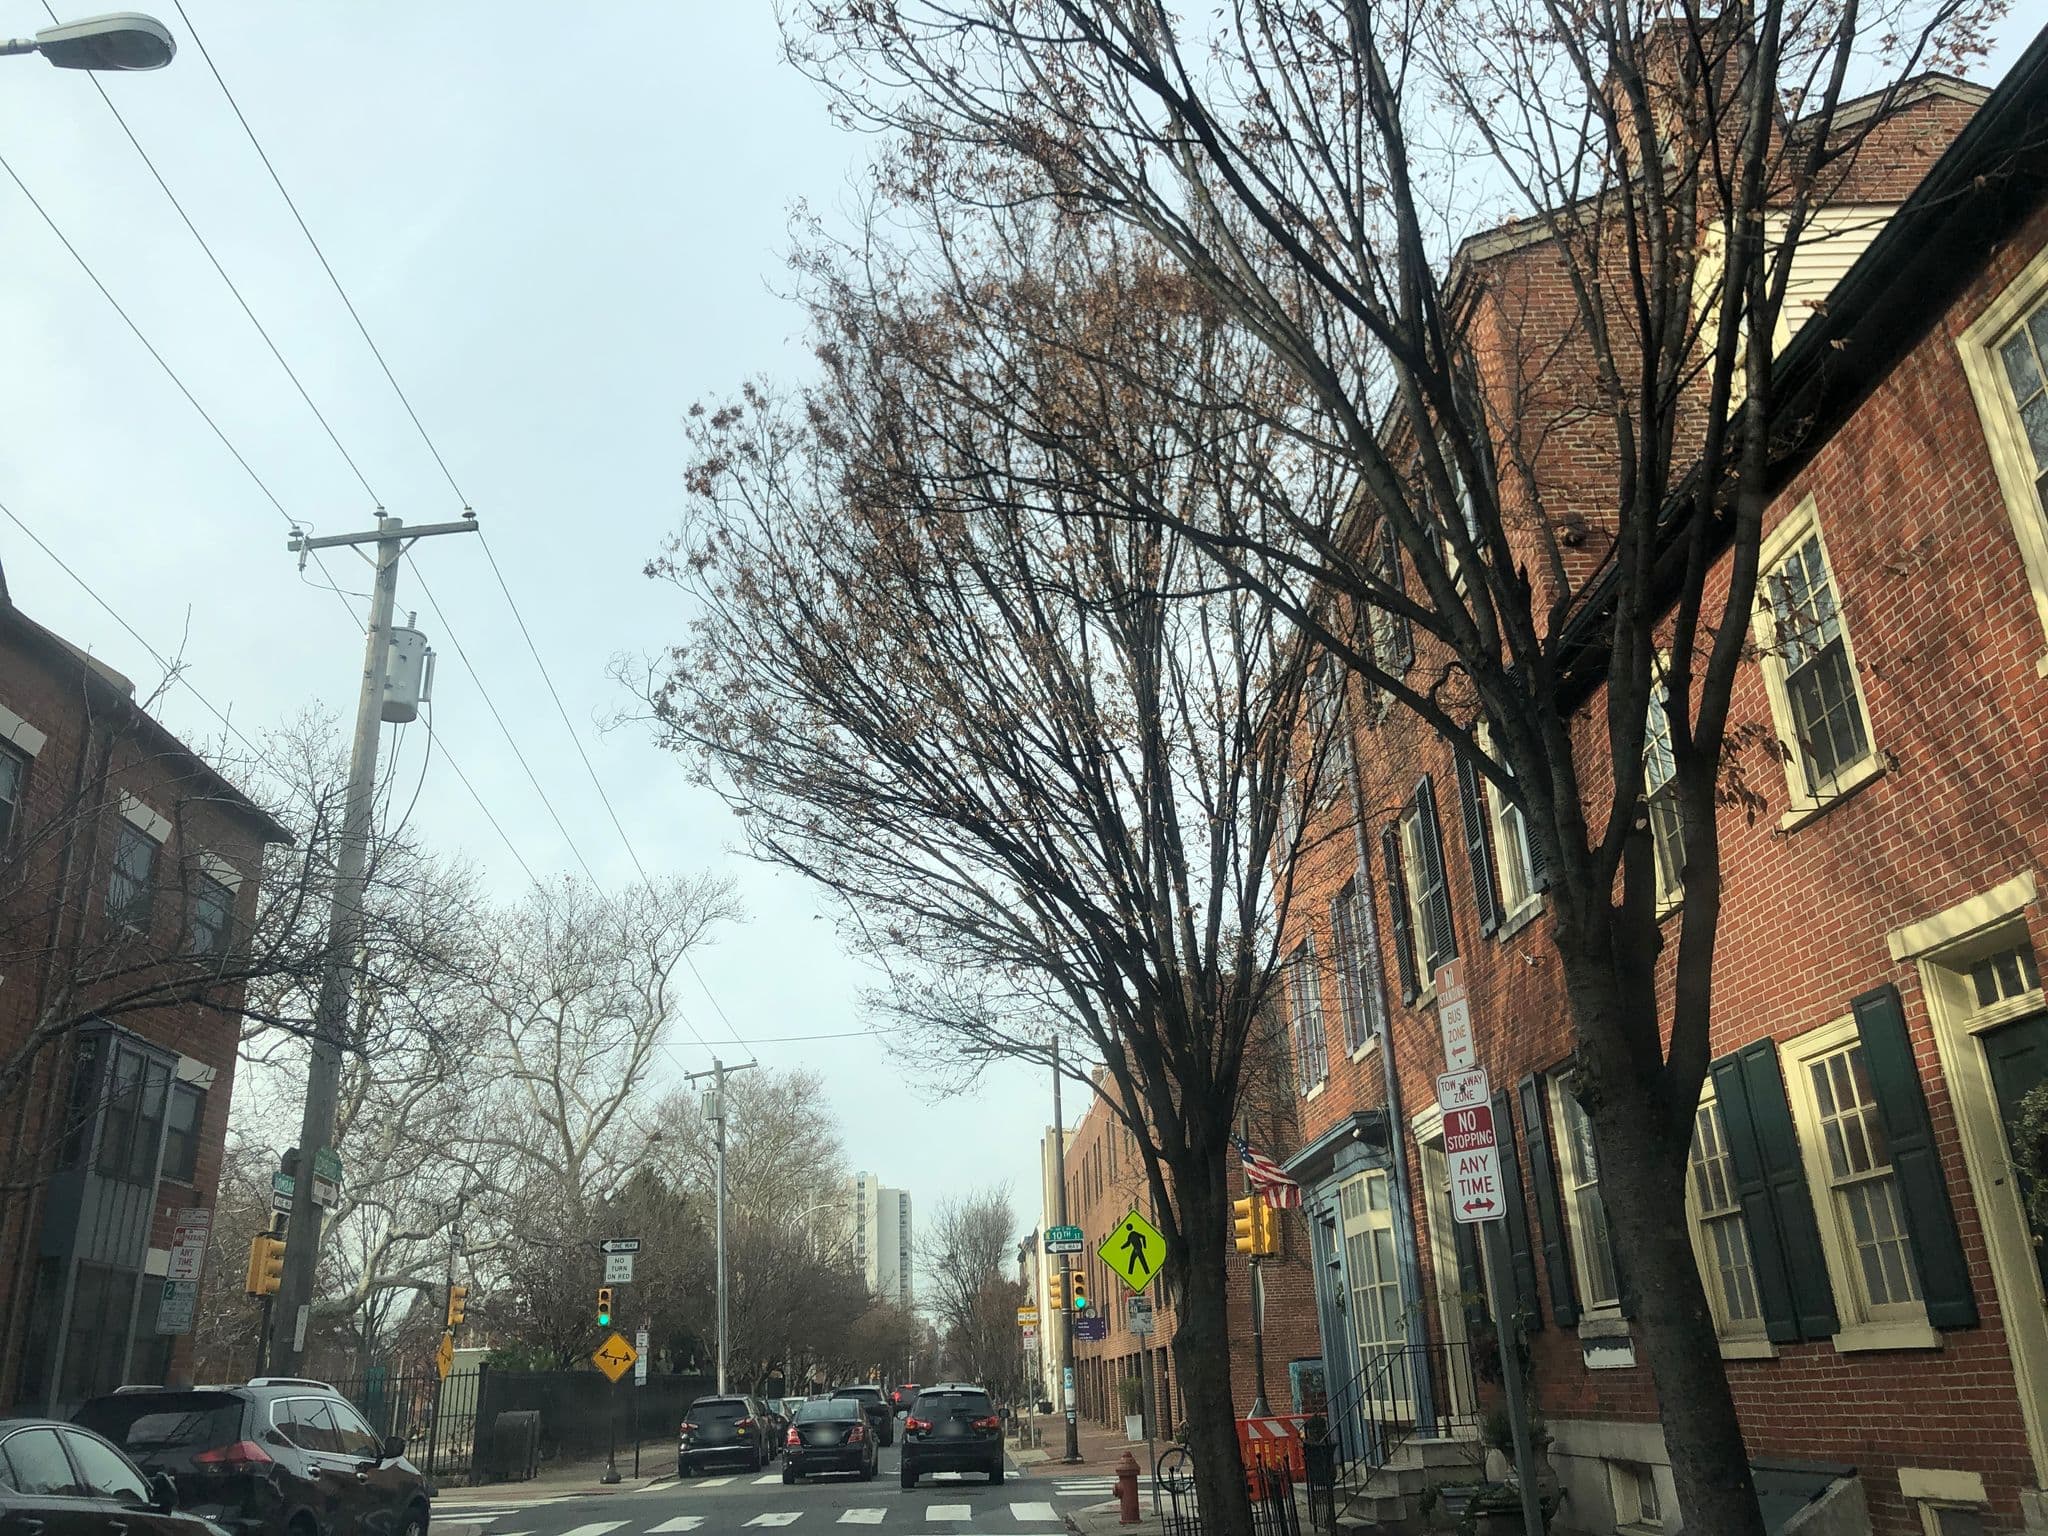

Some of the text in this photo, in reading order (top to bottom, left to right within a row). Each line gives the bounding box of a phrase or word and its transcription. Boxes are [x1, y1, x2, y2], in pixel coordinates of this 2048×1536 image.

[1447, 1007, 1462, 1025] BUS
[1448, 1025, 1467, 1043] ZONE
[1453, 1089, 1475, 1104] ZONE
[1457, 1110, 1477, 1133] NO
[1447, 1129, 1493, 1151] STOPPING
[1459, 1154, 1489, 1176] ANY
[1458, 1175, 1495, 1197] TIME
[1051, 1230, 1070, 1240] 10TH
[178, 1257, 193, 1266] TIME
[180, 1248, 194, 1257] ANY
[166, 1283, 174, 1297] 2
